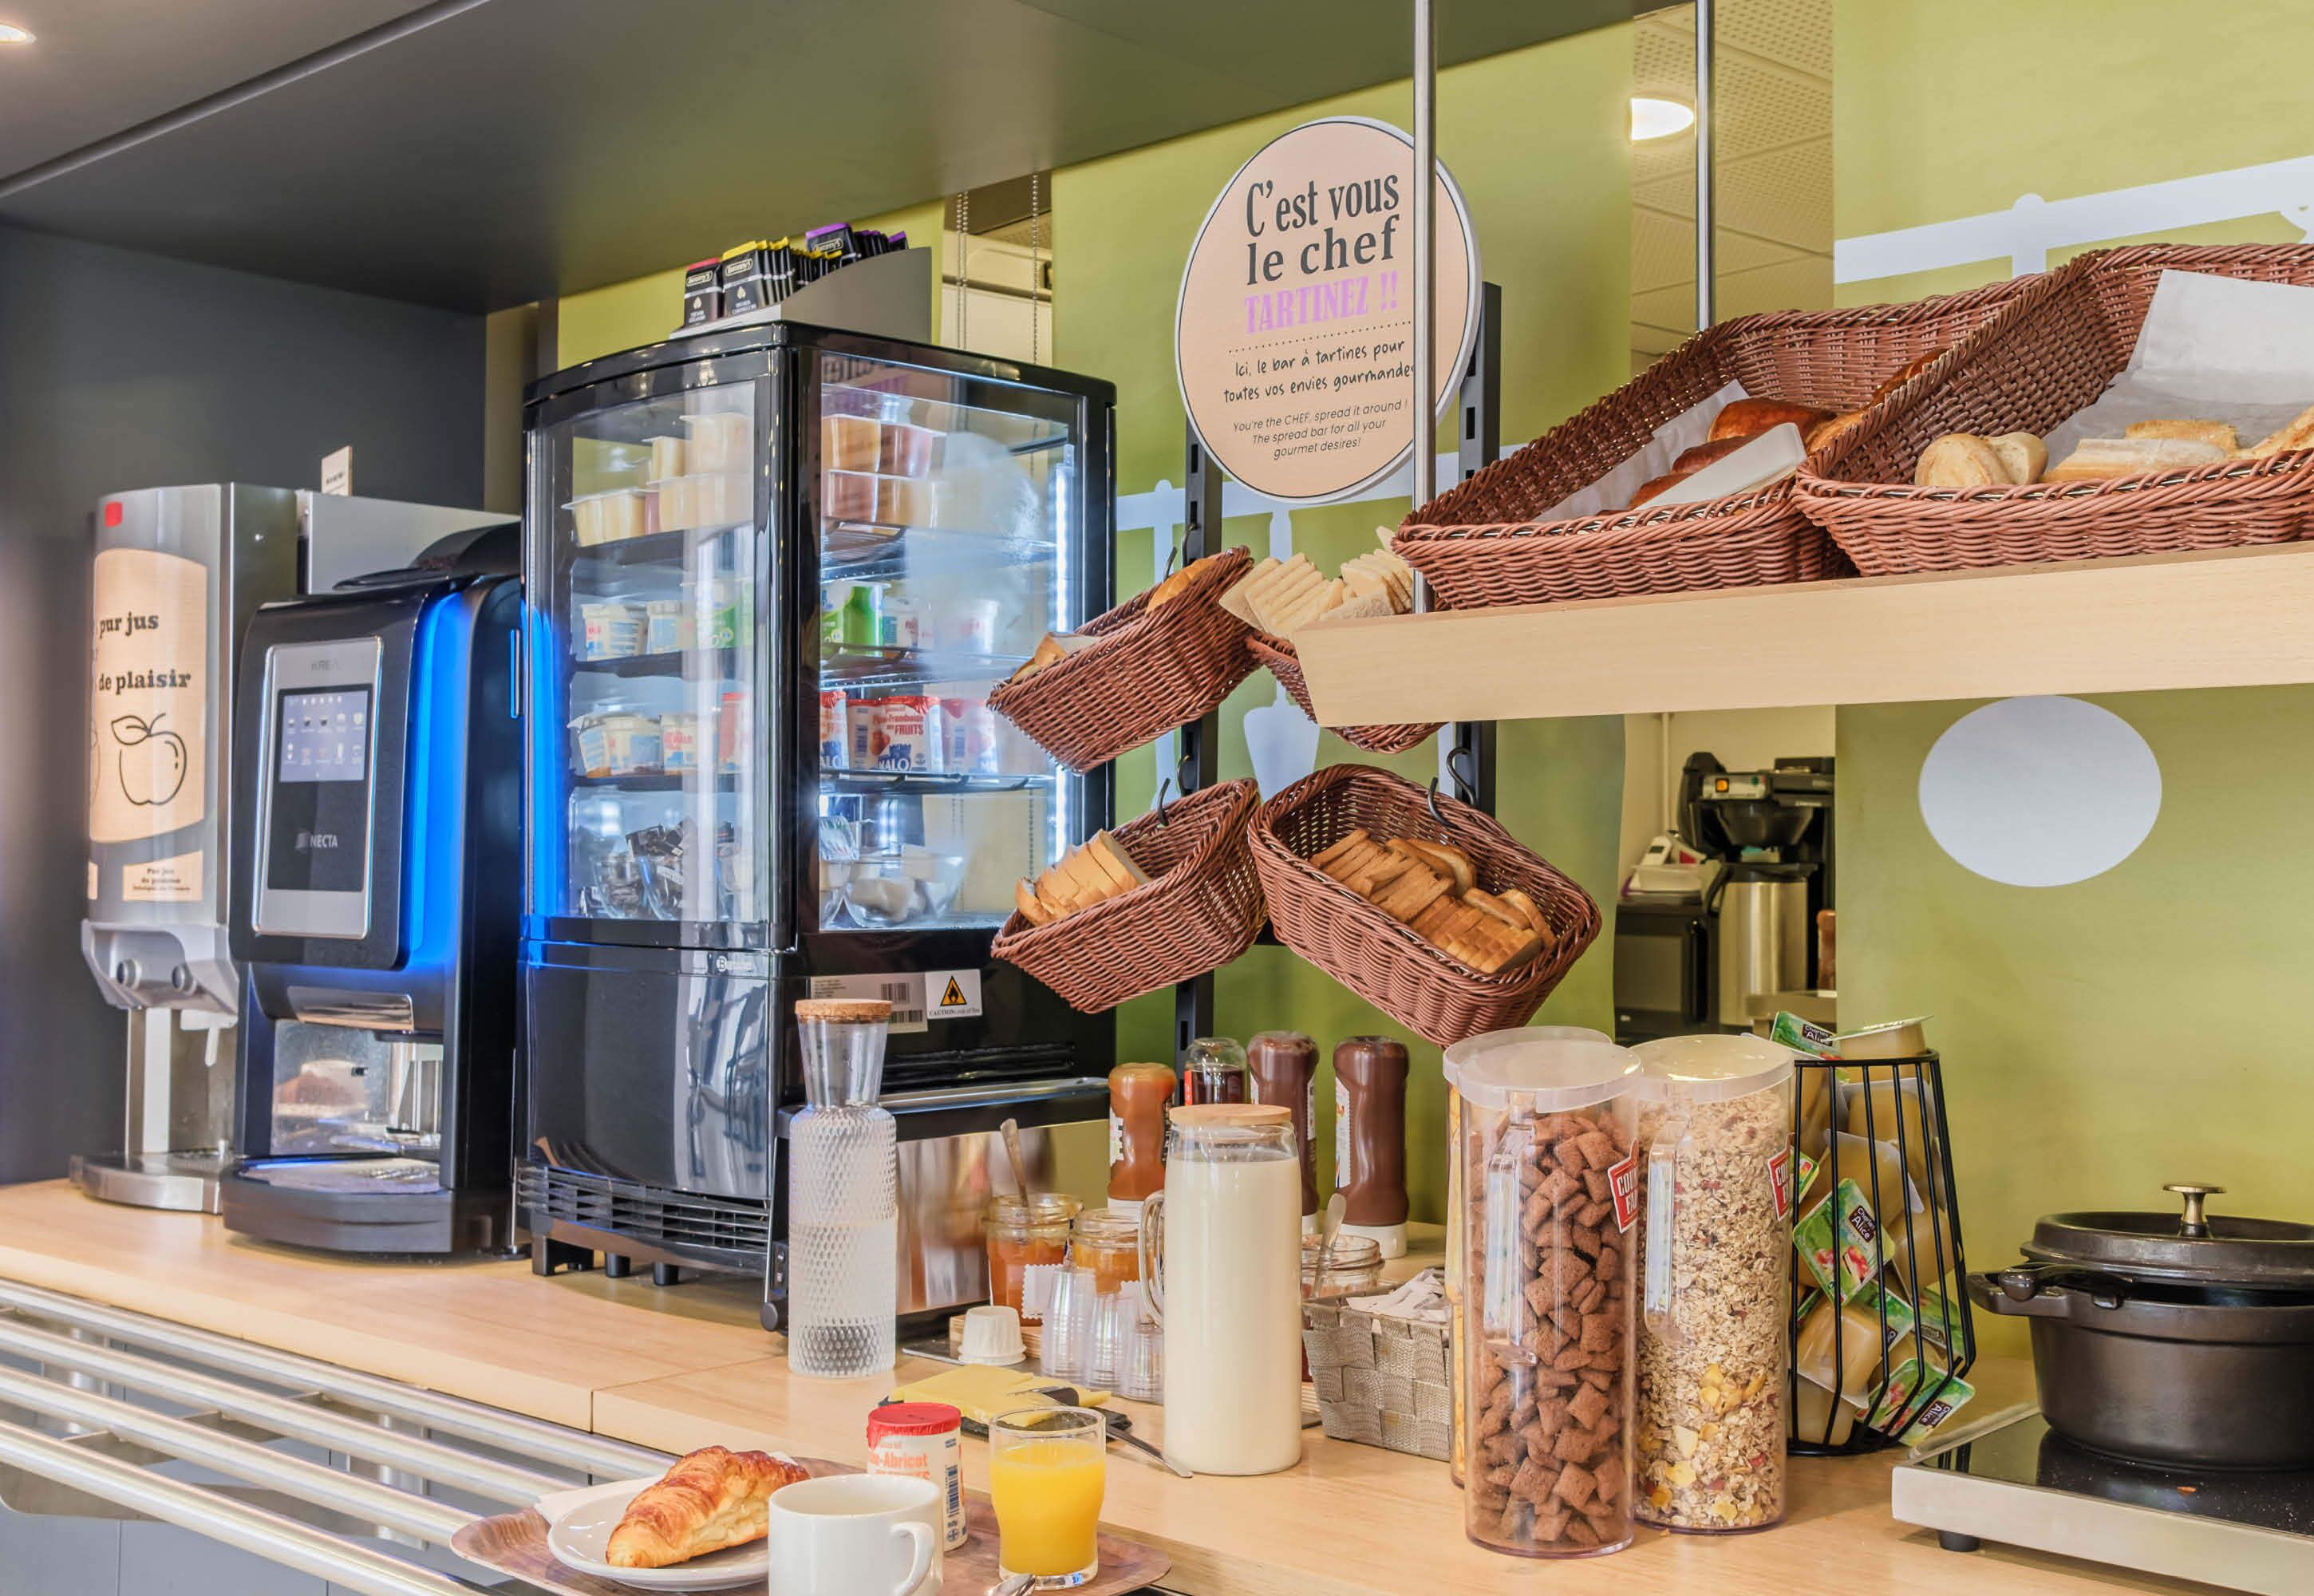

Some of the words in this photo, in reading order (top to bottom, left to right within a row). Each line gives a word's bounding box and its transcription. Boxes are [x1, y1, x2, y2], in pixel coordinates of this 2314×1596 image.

[1246, 180, 1318, 237] C'est
[1328, 174, 1400, 221] vous
[1246, 242, 1284, 286] le
[1300, 213, 1400, 275] chef
[1244, 275, 1369, 334] TARTINEZ
[1380, 270, 1397, 311] !!
[1235, 362, 1251, 377] Ici,
[1258, 359, 1267, 373] le
[1273, 358, 1295, 372] bar
[1301, 349, 1310, 366] à
[1315, 346, 1367, 365] tartines
[1373, 340, 1405, 361] pour
[1223, 386, 1260, 403] toutes
[1265, 383, 1285, 397] vos
[1290, 377, 1328, 394] envies
[1234, 419, 1264, 433] You're
[1266, 417, 1282, 427] the
[1314, 406, 1351, 423] spread
[1353, 403, 1360, 416] it
[1363, 400, 1402, 414] around
[1252, 433, 1270, 447] The
[1273, 429, 1308, 446] spread
[1311, 426, 1328, 437] bar
[1330, 423, 1345, 435] for
[1347, 420, 1360, 432] all
[1362, 419, 1386, 434] your
[1273, 441, 1318, 460] gourmet
[1320, 437, 1361, 452] desires!
[100, 617, 122, 639] pur
[125, 610, 159, 637] jus
[99, 673, 112, 692] de
[116, 668, 192, 696] plaisir
[895, 725, 924, 735] FRUITS
[310, 835, 338, 848] NECTA
[1851, 1215, 1870, 1239] Alice
[1921, 1404, 1942, 1423] Alice
